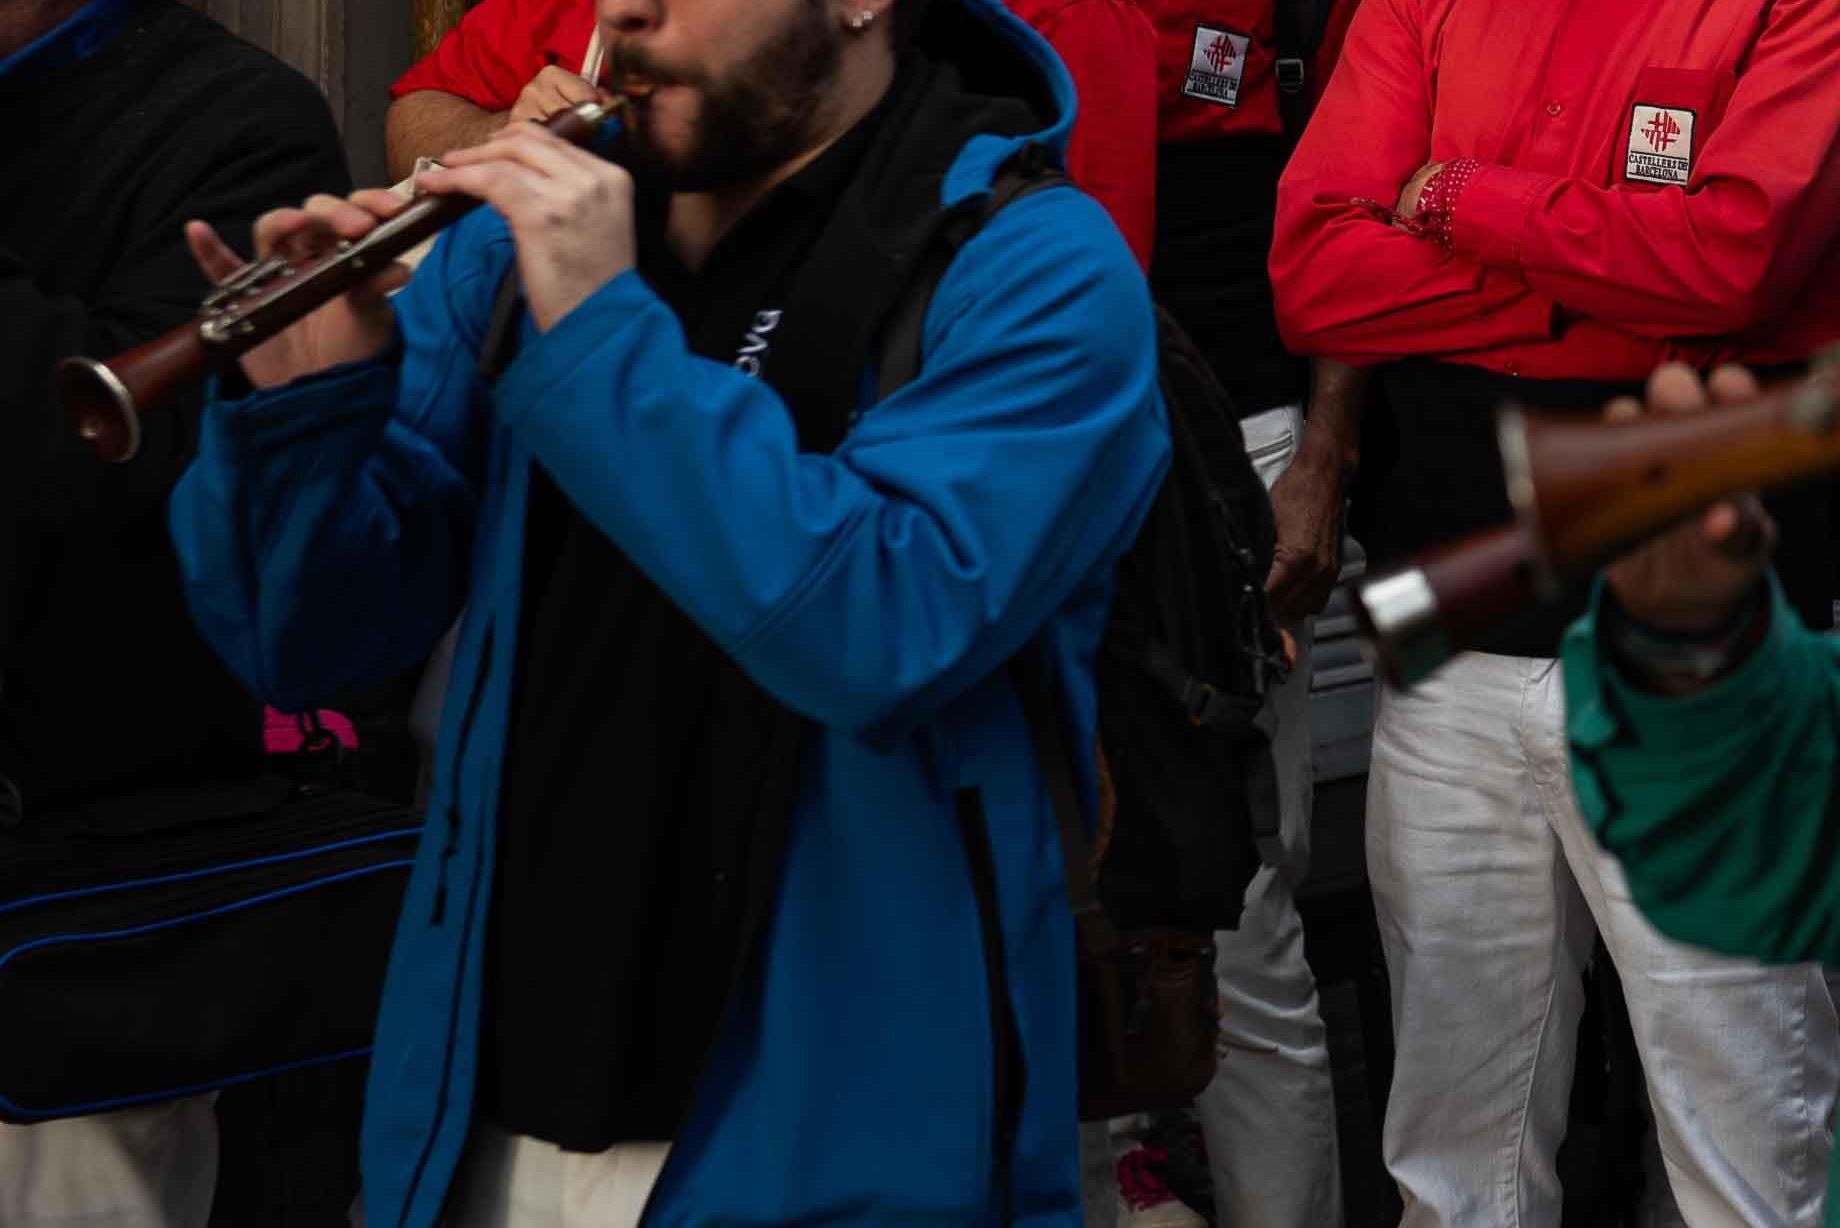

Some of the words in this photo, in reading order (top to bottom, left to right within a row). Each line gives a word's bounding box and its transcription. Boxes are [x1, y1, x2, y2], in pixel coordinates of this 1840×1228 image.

[1628, 154, 1677, 169] CASTELLERS
[1677, 160, 1688, 171] DE
[1635, 165, 1679, 180] BARCELONA
